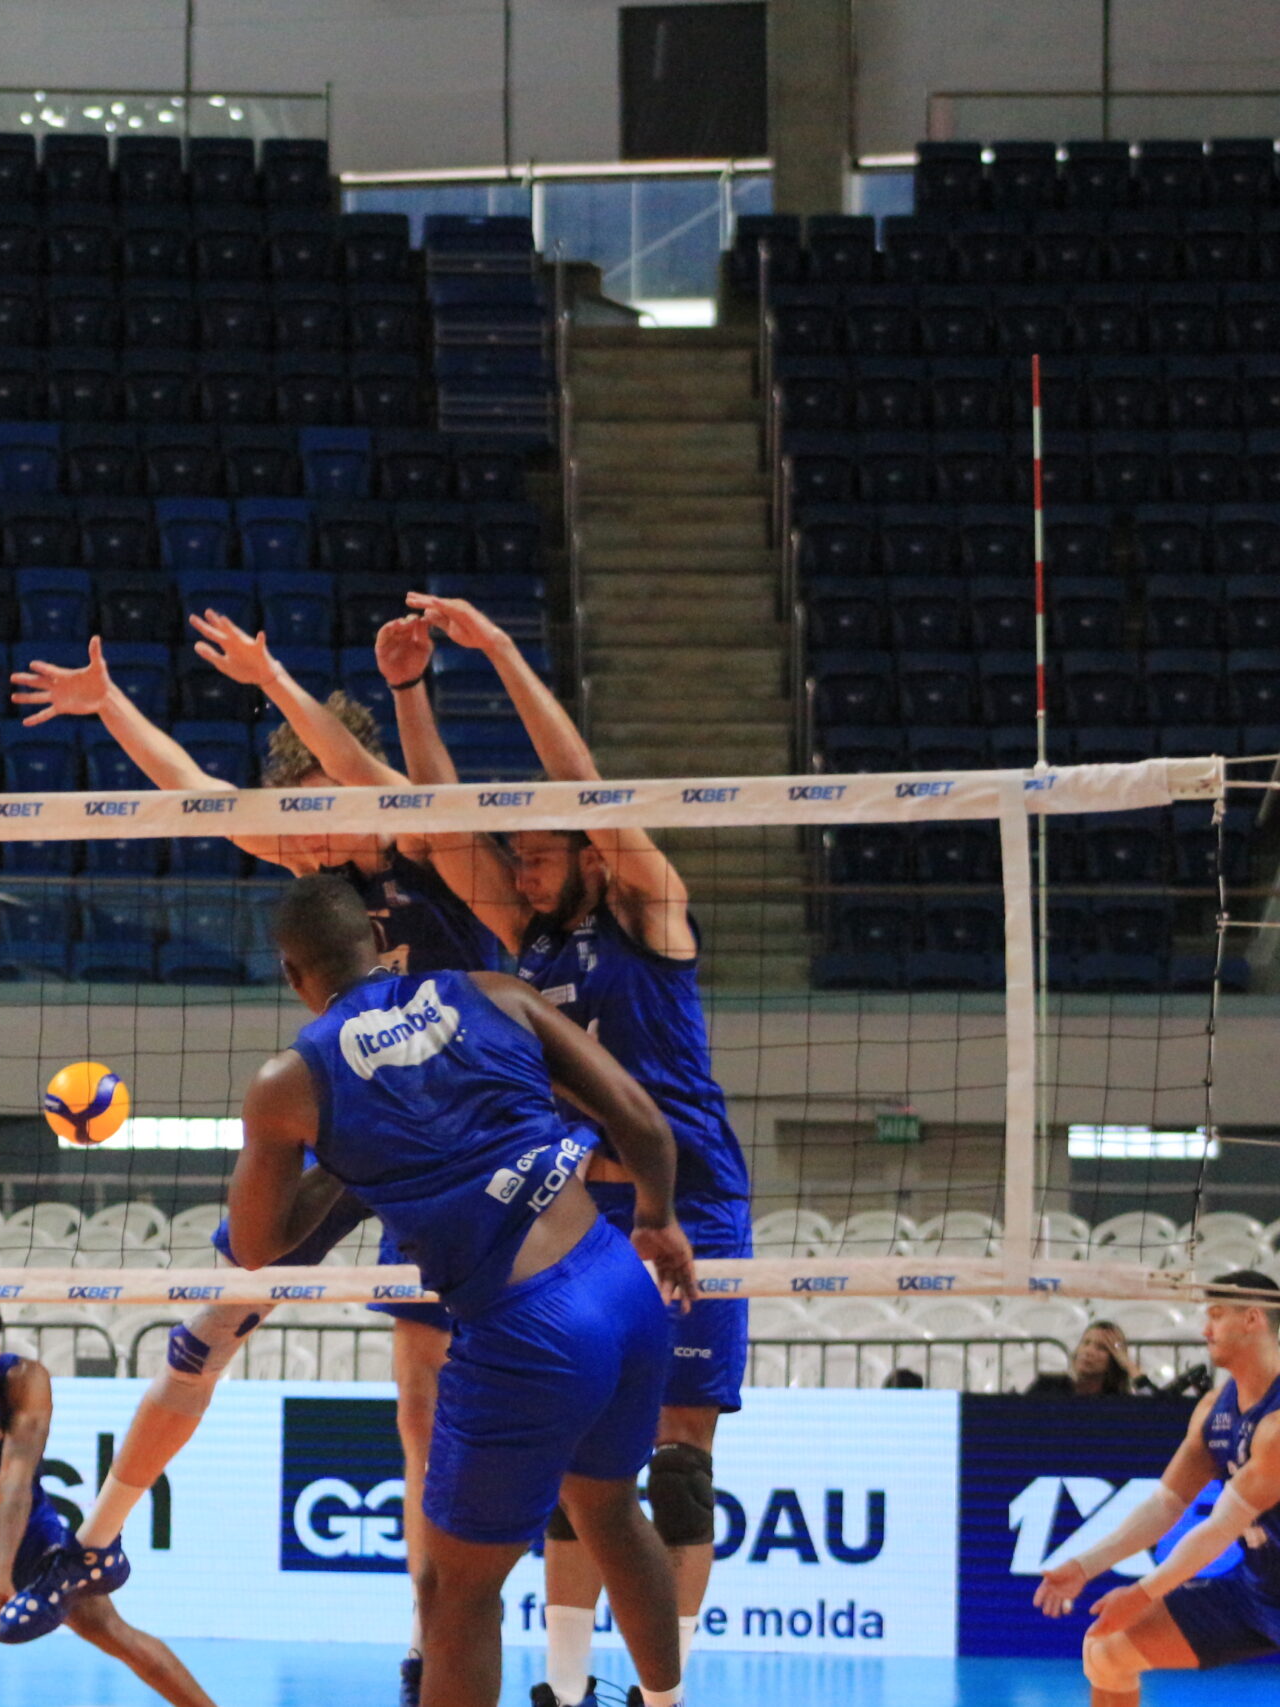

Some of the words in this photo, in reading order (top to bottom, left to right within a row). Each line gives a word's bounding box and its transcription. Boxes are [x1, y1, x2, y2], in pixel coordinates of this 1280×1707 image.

[84, 800, 140, 815] 1XBET
[181, 797, 238, 813] 1XBET
[279, 796, 337, 812] 1XBET
[377, 793, 435, 809] 1XBET
[477, 791, 535, 807] 1XBET
[577, 788, 636, 805] 1XBET
[681, 786, 741, 803] 1XBET
[787, 784, 848, 800] 1XBET
[895, 780, 955, 798] 1XBET
[67, 1286, 123, 1299] 1XBET
[168, 1286, 224, 1300] 1XBET
[269, 1286, 326, 1300] 1XBET
[790, 1277, 849, 1292] 1XBET
[896, 1275, 956, 1291] 1XBET
[743, 1598, 884, 1639] molda
